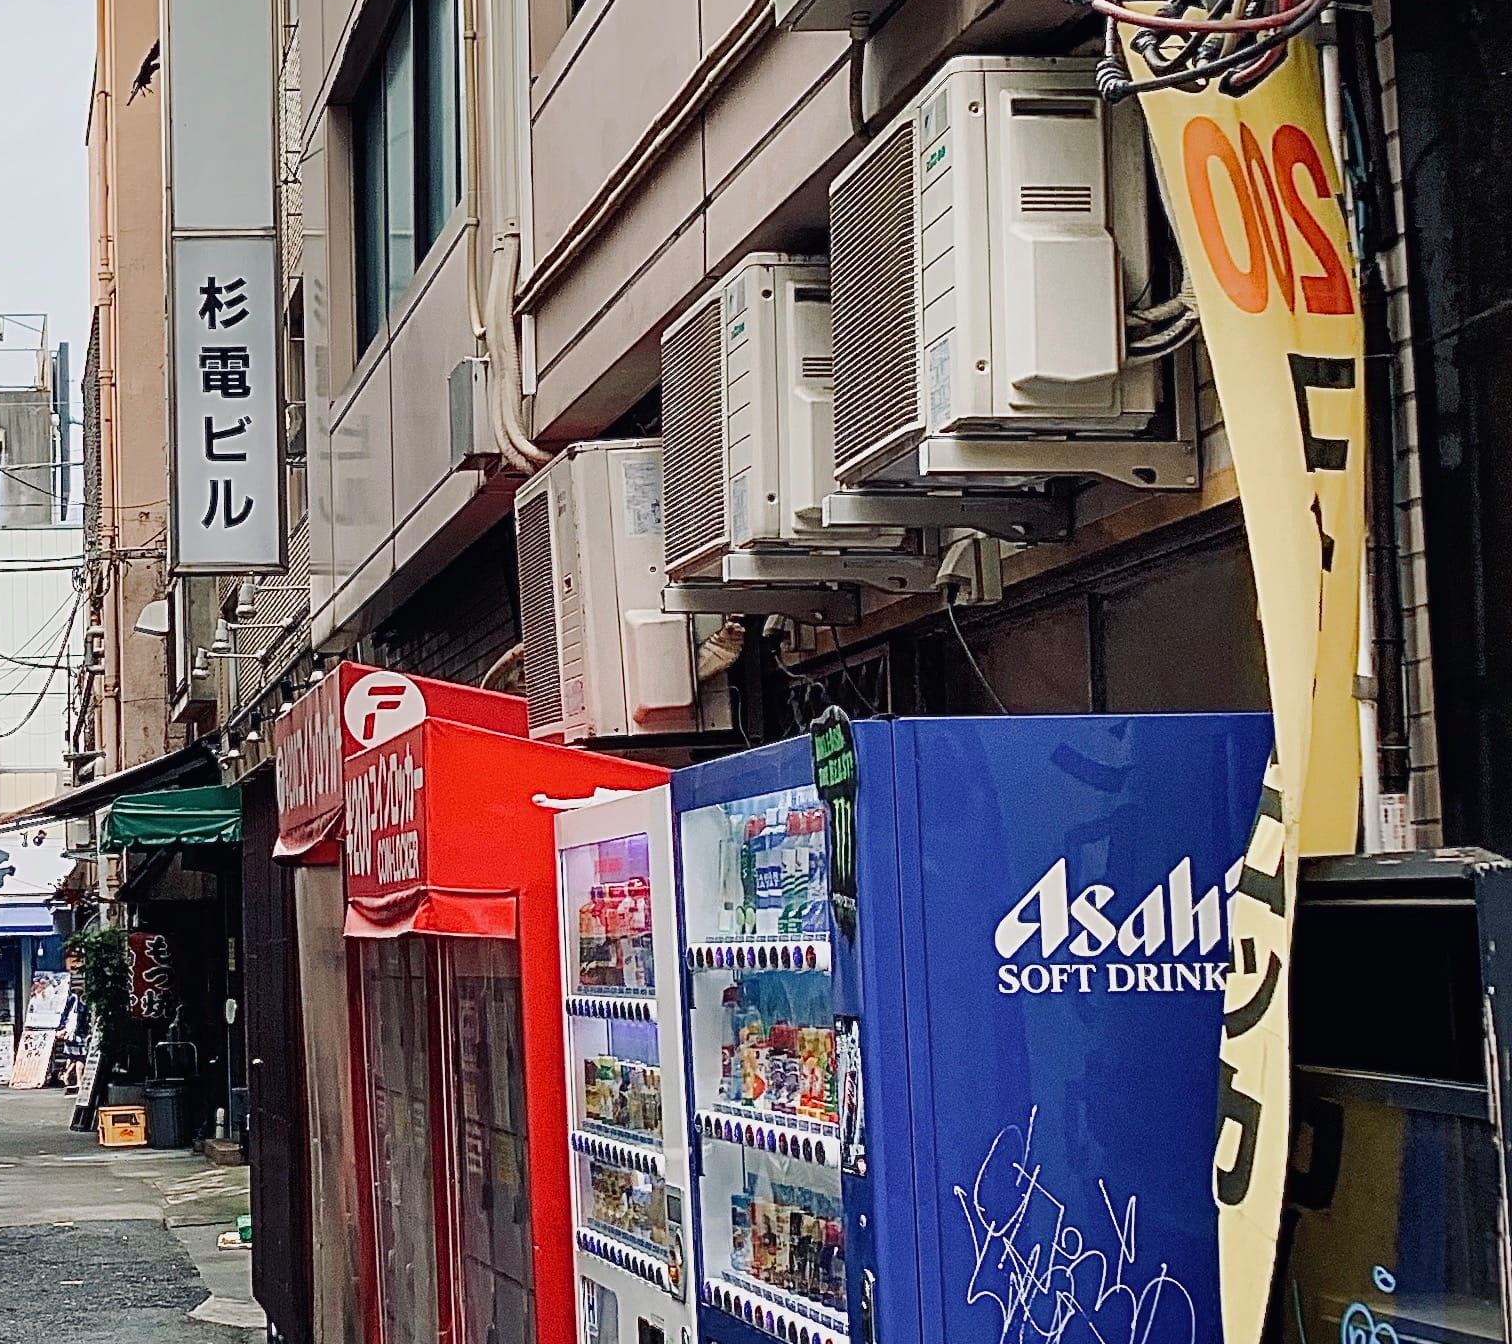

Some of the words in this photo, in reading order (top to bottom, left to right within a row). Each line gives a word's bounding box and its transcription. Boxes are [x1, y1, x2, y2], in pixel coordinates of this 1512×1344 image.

[198, 276, 253, 529] 杉電ビル
[998, 963, 1097, 994] SOFT
